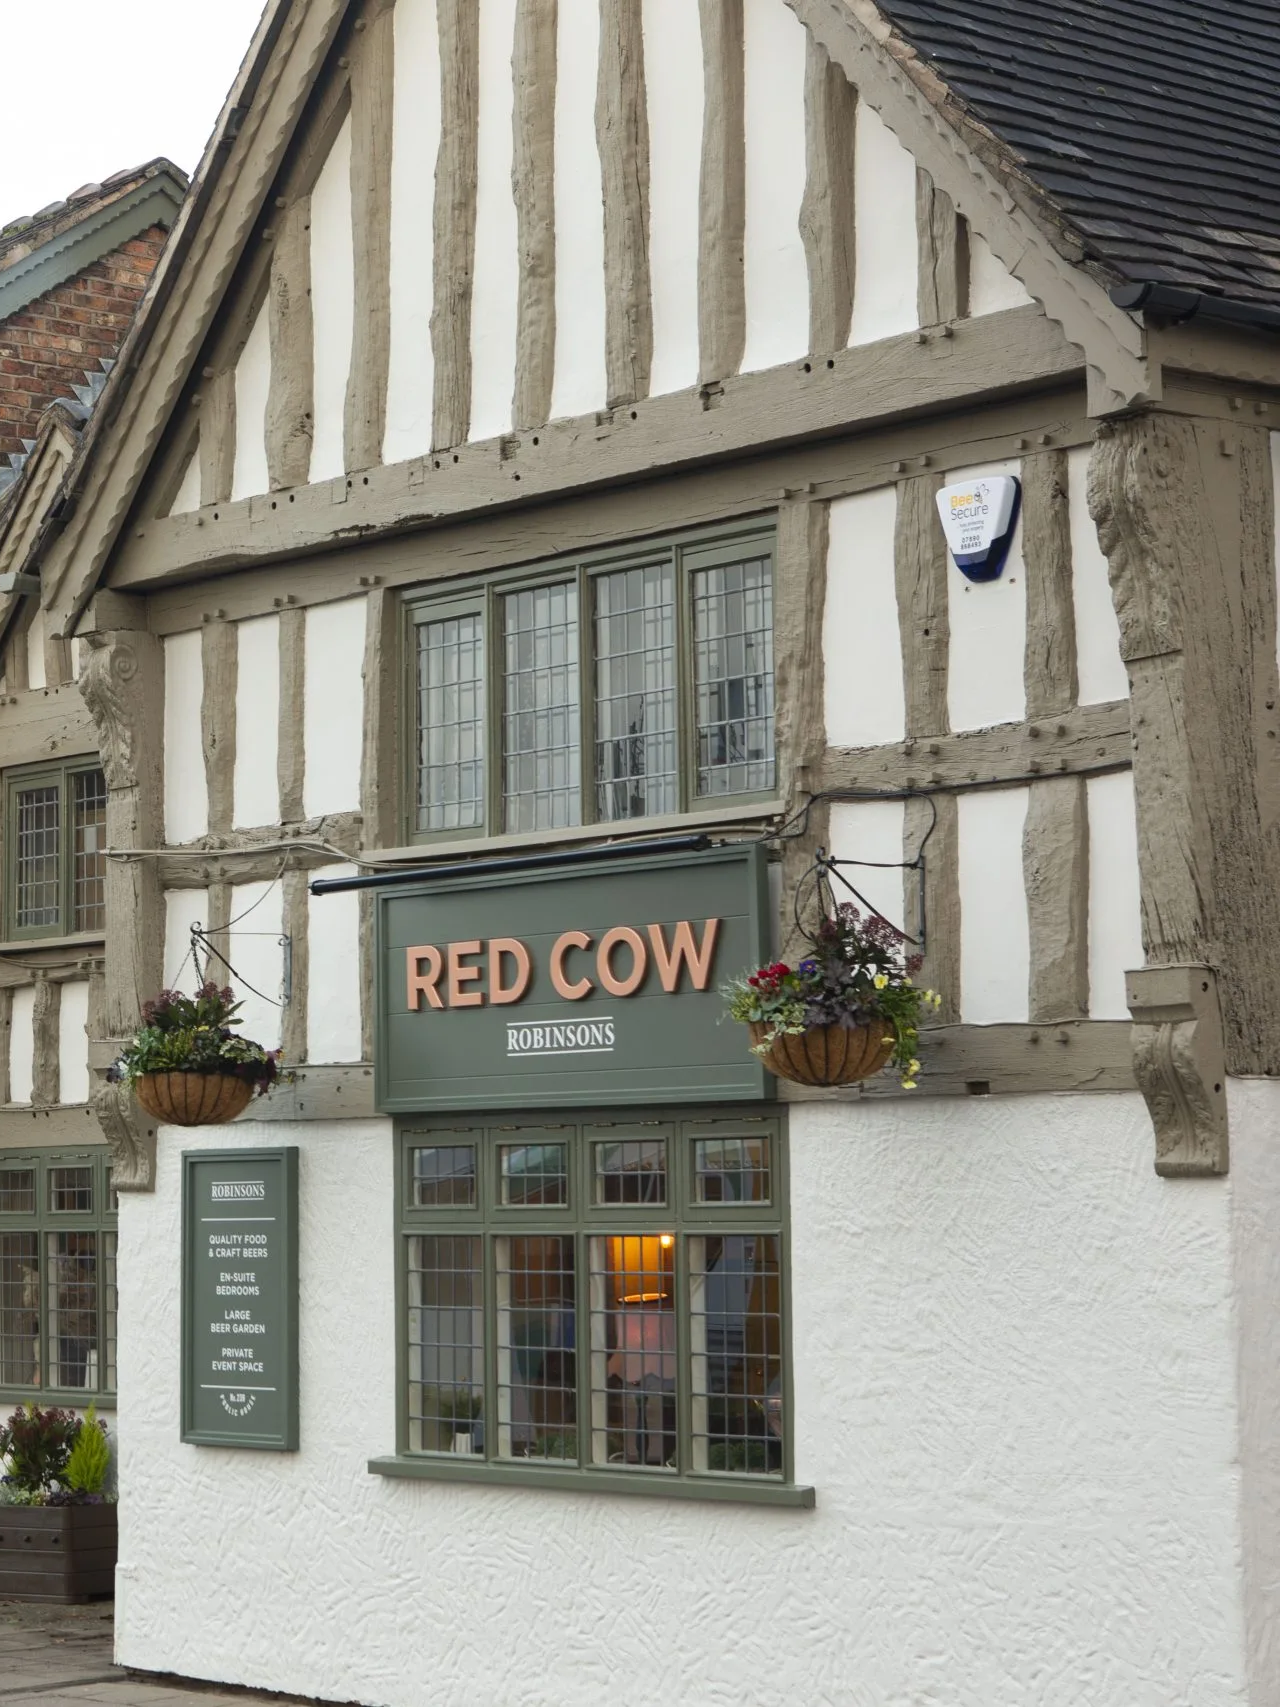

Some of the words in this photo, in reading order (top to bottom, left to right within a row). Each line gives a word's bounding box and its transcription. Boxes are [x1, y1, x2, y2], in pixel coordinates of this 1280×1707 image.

[951, 495, 973, 507] Bee
[950, 504, 988, 520] Secure
[405, 937, 533, 1011] RED
[549, 917, 722, 1001] COW
[506, 1022, 616, 1051] ROBINSONS
[211, 1184, 265, 1199] ROBINSONS
[209, 1235, 243, 1245] QUALITY
[244, 1234, 267, 1245] FOOD
[208, 1248, 214, 1258] &
[215, 1248, 241, 1258] CRAFT
[242, 1248, 268, 1258] BEERS
[220, 1272, 256, 1283] EN-SUITE
[216, 1286, 260, 1296] BEDROOMS
[224, 1310, 251, 1320] LARGE
[210, 1323, 231, 1333] BEER
[232, 1323, 266, 1334] GARDEN
[221, 1348, 253, 1359] PRIVATE
[212, 1361, 237, 1372] EVENT
[238, 1361, 264, 1372] SPACE
